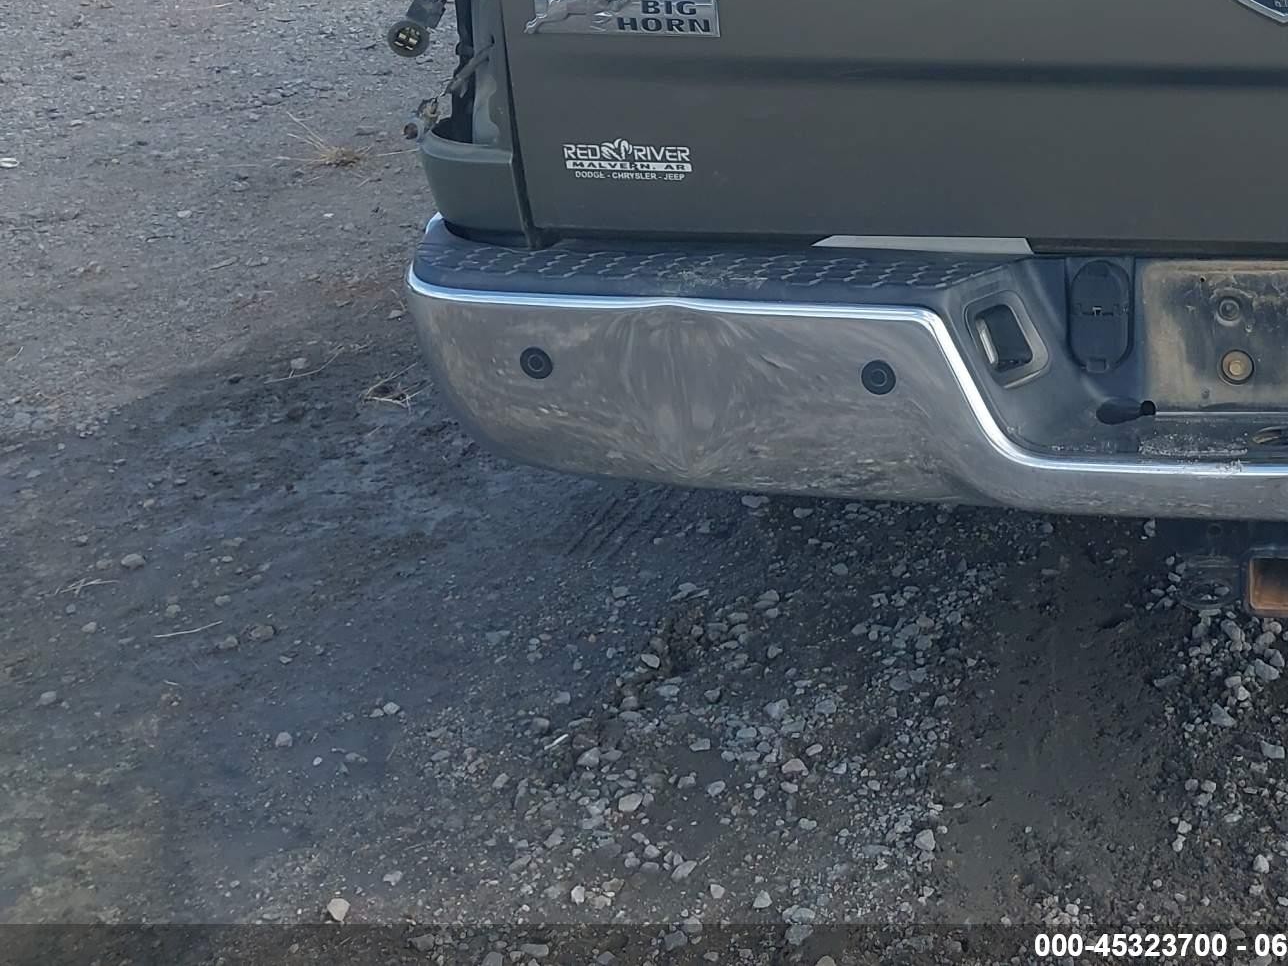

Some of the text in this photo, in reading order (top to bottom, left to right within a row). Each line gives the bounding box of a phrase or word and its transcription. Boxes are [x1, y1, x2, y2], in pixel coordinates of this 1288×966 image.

[641, 0, 697, 16] BIG
[617, 17, 711, 33] HORN
[563, 144, 690, 162] RED RIVER
[575, 170, 606, 179] DODGE
[611, 172, 657, 180] CHRYSLER
[663, 173, 686, 181] JEEP
